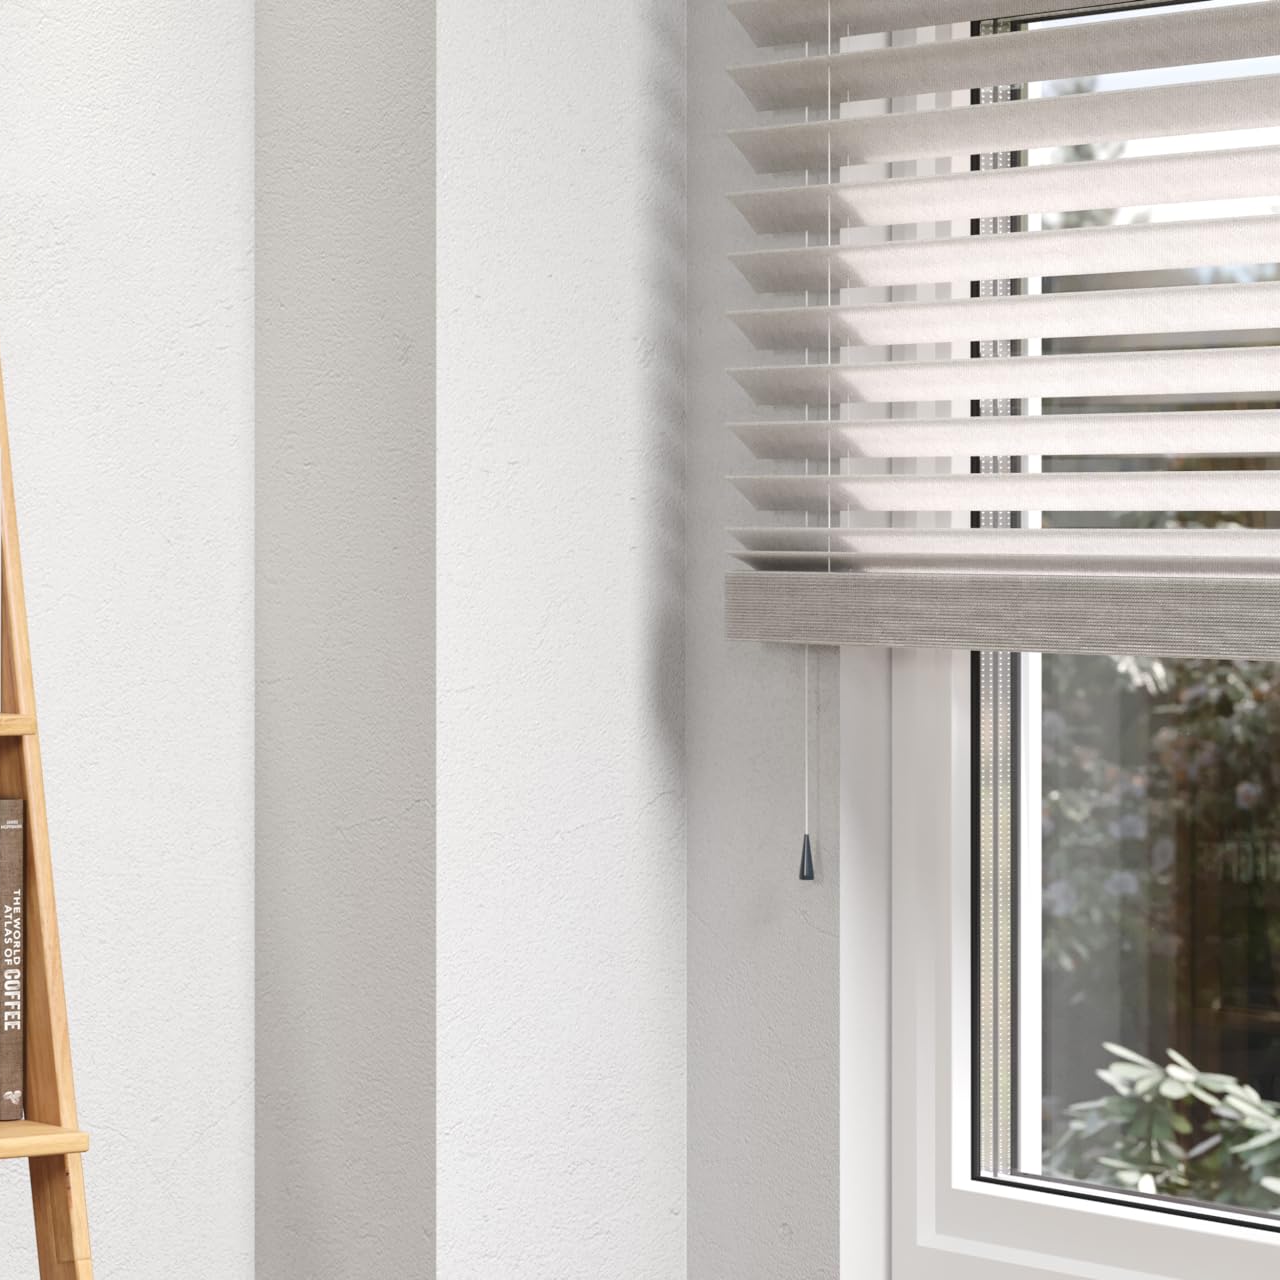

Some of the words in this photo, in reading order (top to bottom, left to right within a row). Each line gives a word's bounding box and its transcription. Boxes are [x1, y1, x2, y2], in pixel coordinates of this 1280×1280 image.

[12, 889, 20, 913] THE
[4, 905, 12, 943] ATLAS
[12, 918, 20, 965] WORLD
[4, 949, 12, 965] OF
[4, 969, 20, 1031] COFFEE
